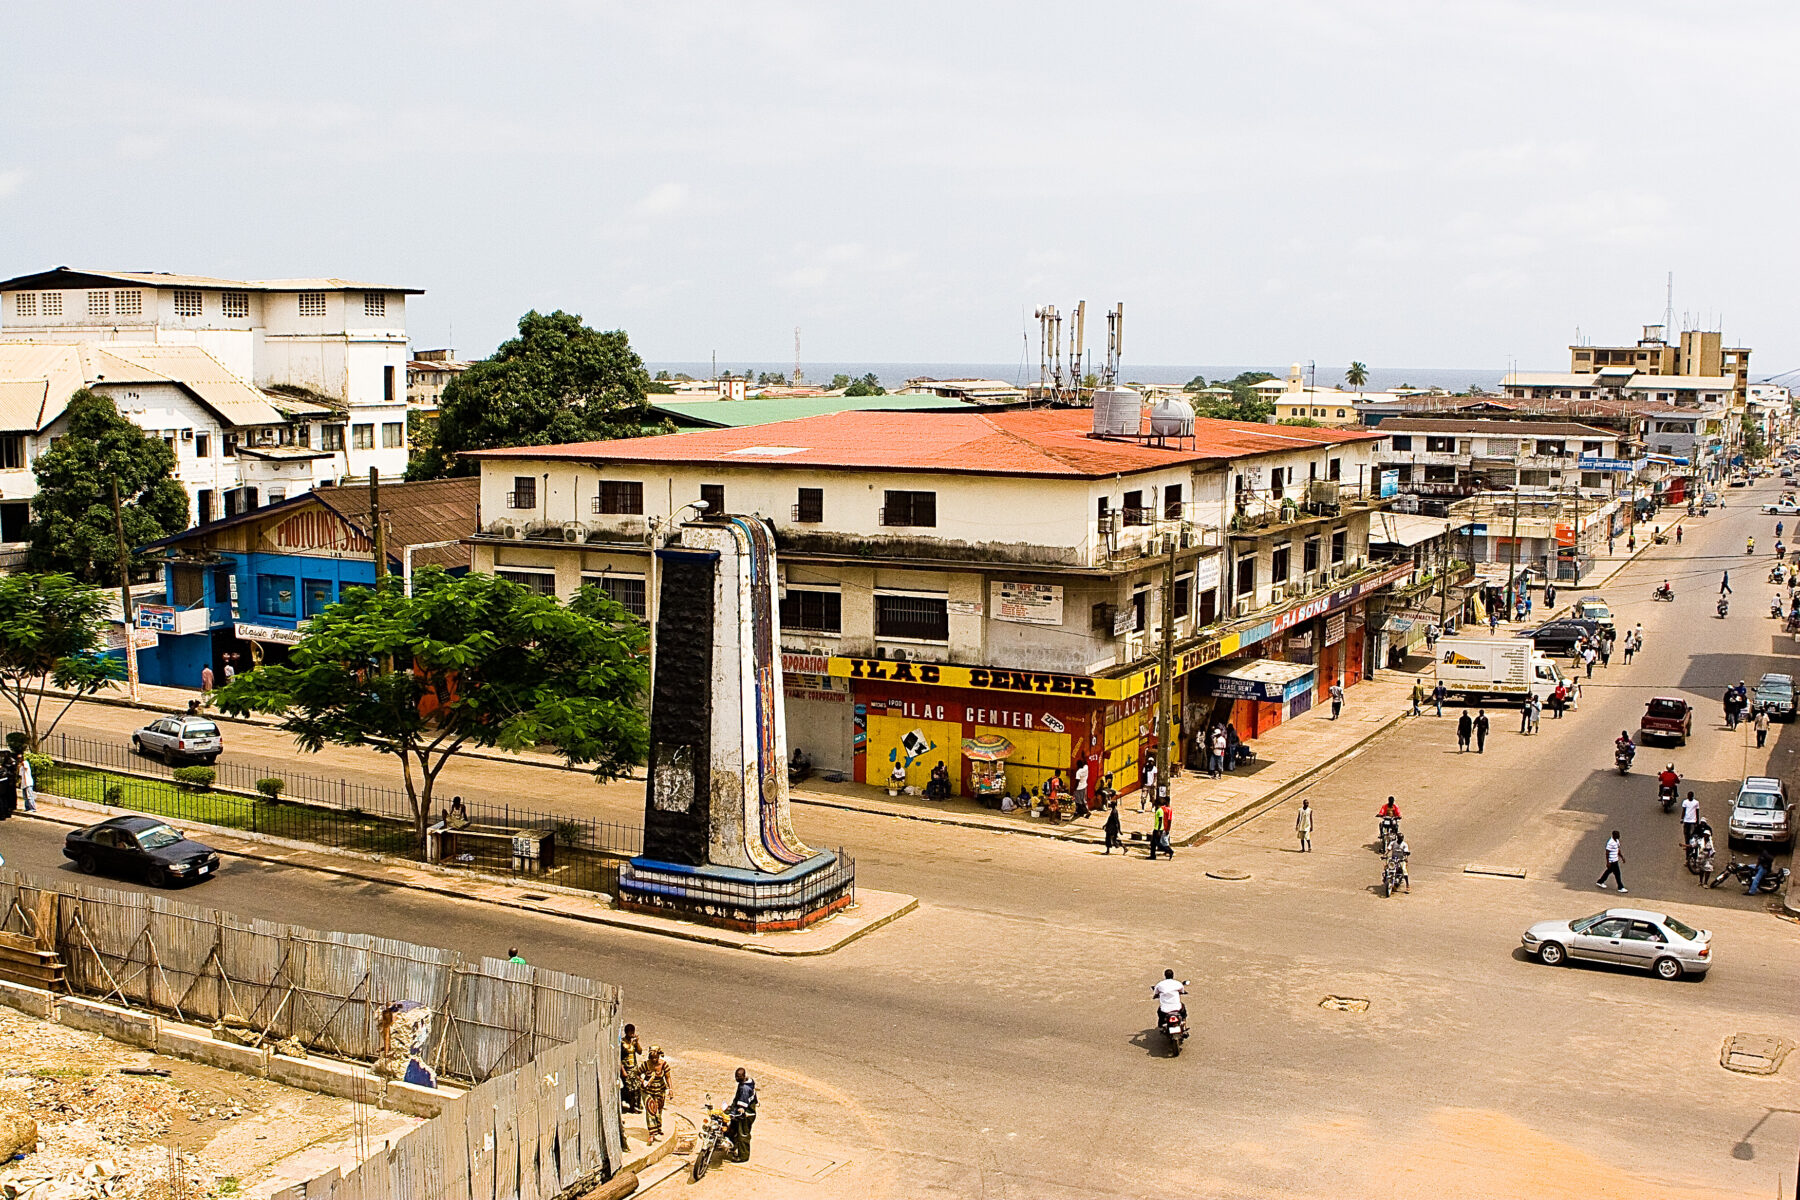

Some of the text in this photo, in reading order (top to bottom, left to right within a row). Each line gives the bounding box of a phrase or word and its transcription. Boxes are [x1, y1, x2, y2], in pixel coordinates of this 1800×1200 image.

[277, 511, 314, 548] PHOTO
[317, 510, 338, 550] ONE
[1298, 596, 1330, 622] SONS
[239, 625, 267, 637] Classic
[1444, 650, 1455, 664] GO
[850, 659, 940, 683] ILAC
[969, 669, 1096, 696] CENTER
[904, 702, 1033, 728] ILAC CENTER
[1115, 698, 1136, 721] ILAC
